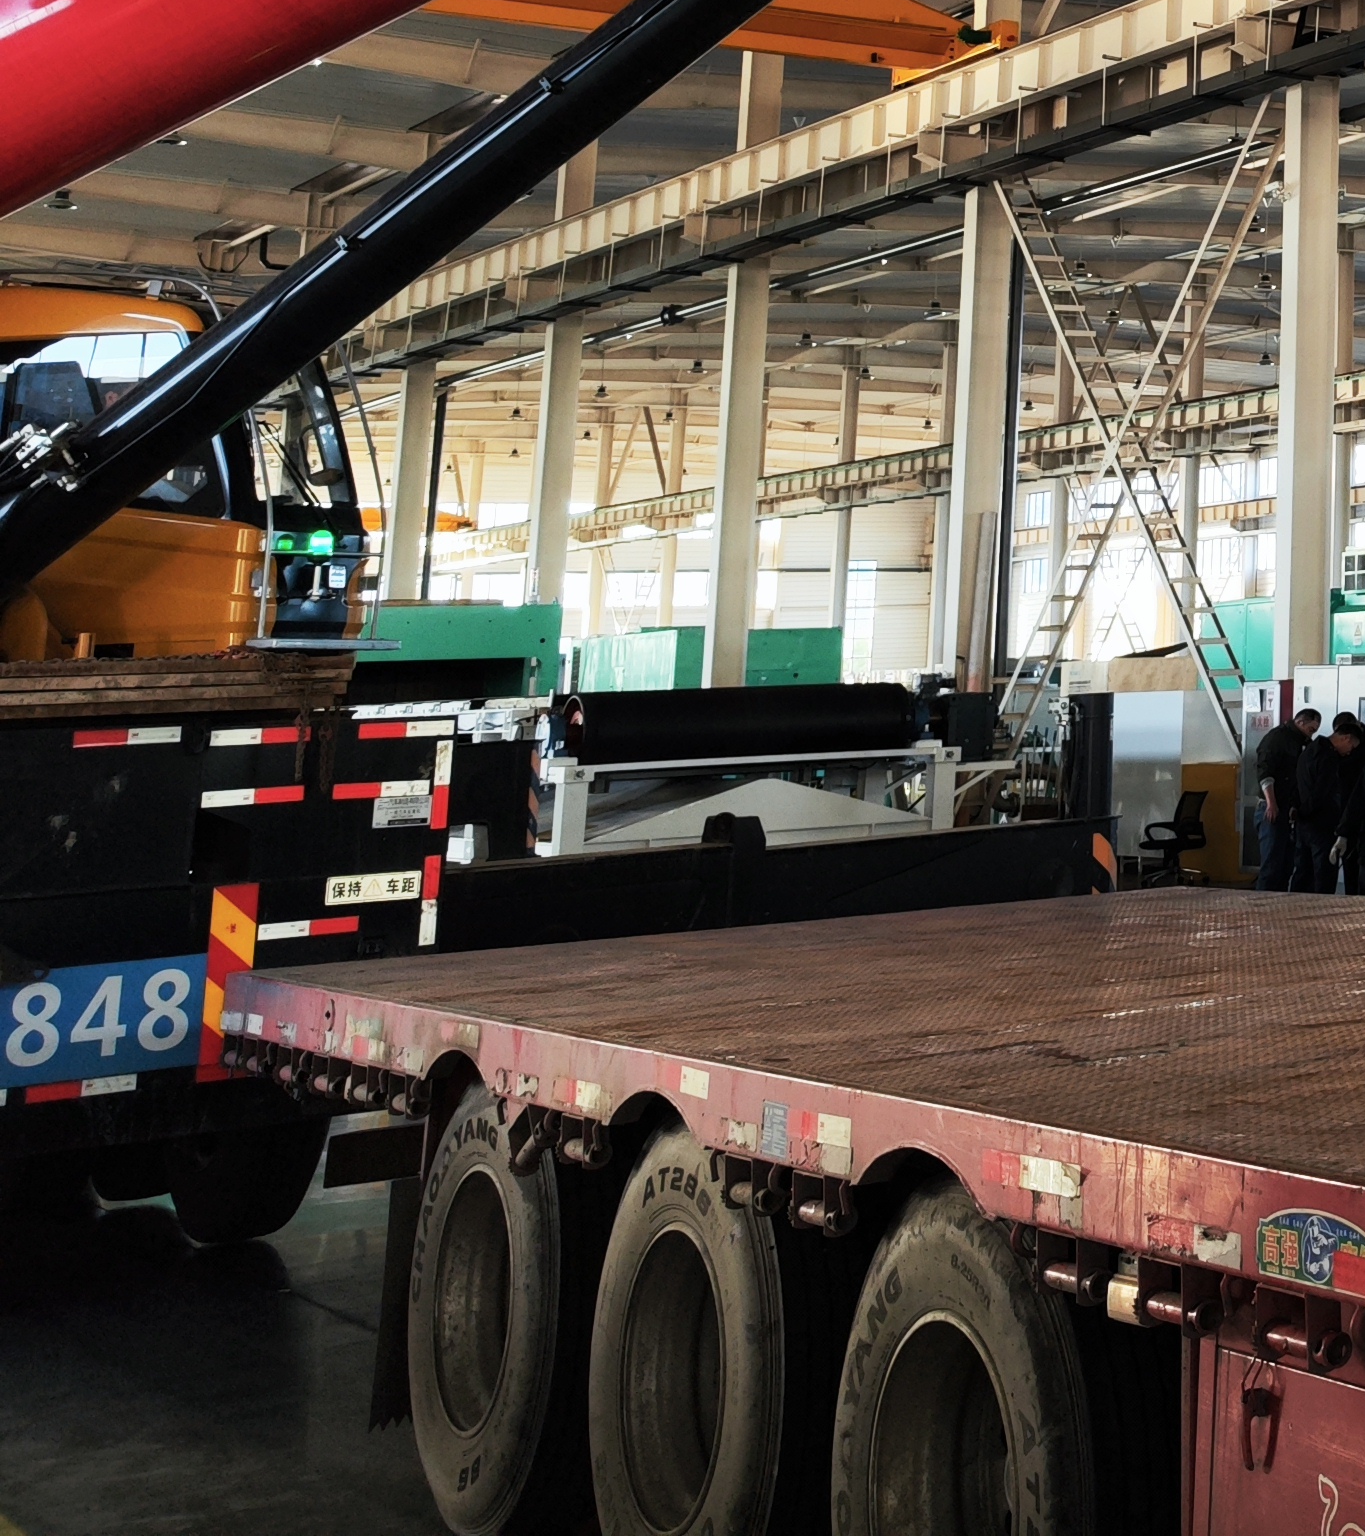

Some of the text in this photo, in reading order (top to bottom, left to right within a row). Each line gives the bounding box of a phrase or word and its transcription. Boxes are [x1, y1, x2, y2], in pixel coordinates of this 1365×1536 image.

[332, 876, 416, 899] 保持 车距
[5, 968, 192, 1068] 848
[1261, 1224, 1300, 1270] 高强
